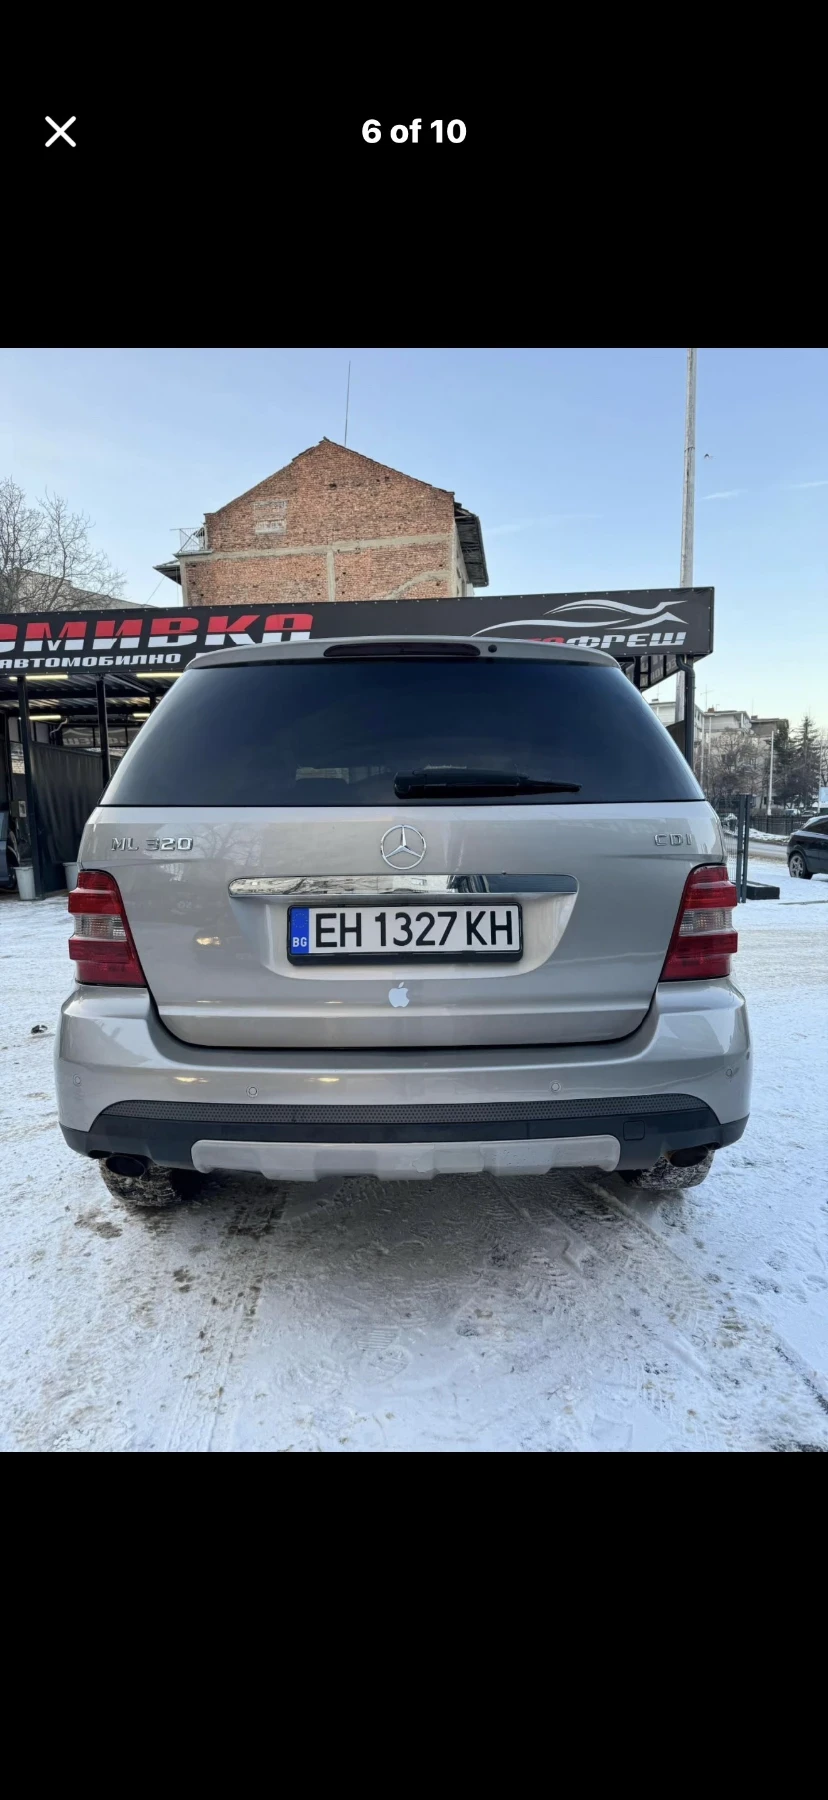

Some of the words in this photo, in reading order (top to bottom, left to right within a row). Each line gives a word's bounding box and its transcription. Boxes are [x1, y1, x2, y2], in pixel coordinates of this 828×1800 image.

[110, 836, 140, 851] ML
[145, 836, 194, 851] 320
[653, 832, 693, 847] CDI
[315, 912, 363, 948] EH
[374, 911, 458, 947] 1327
[465, 910, 513, 946] KH
[292, 936, 308, 948] BG
